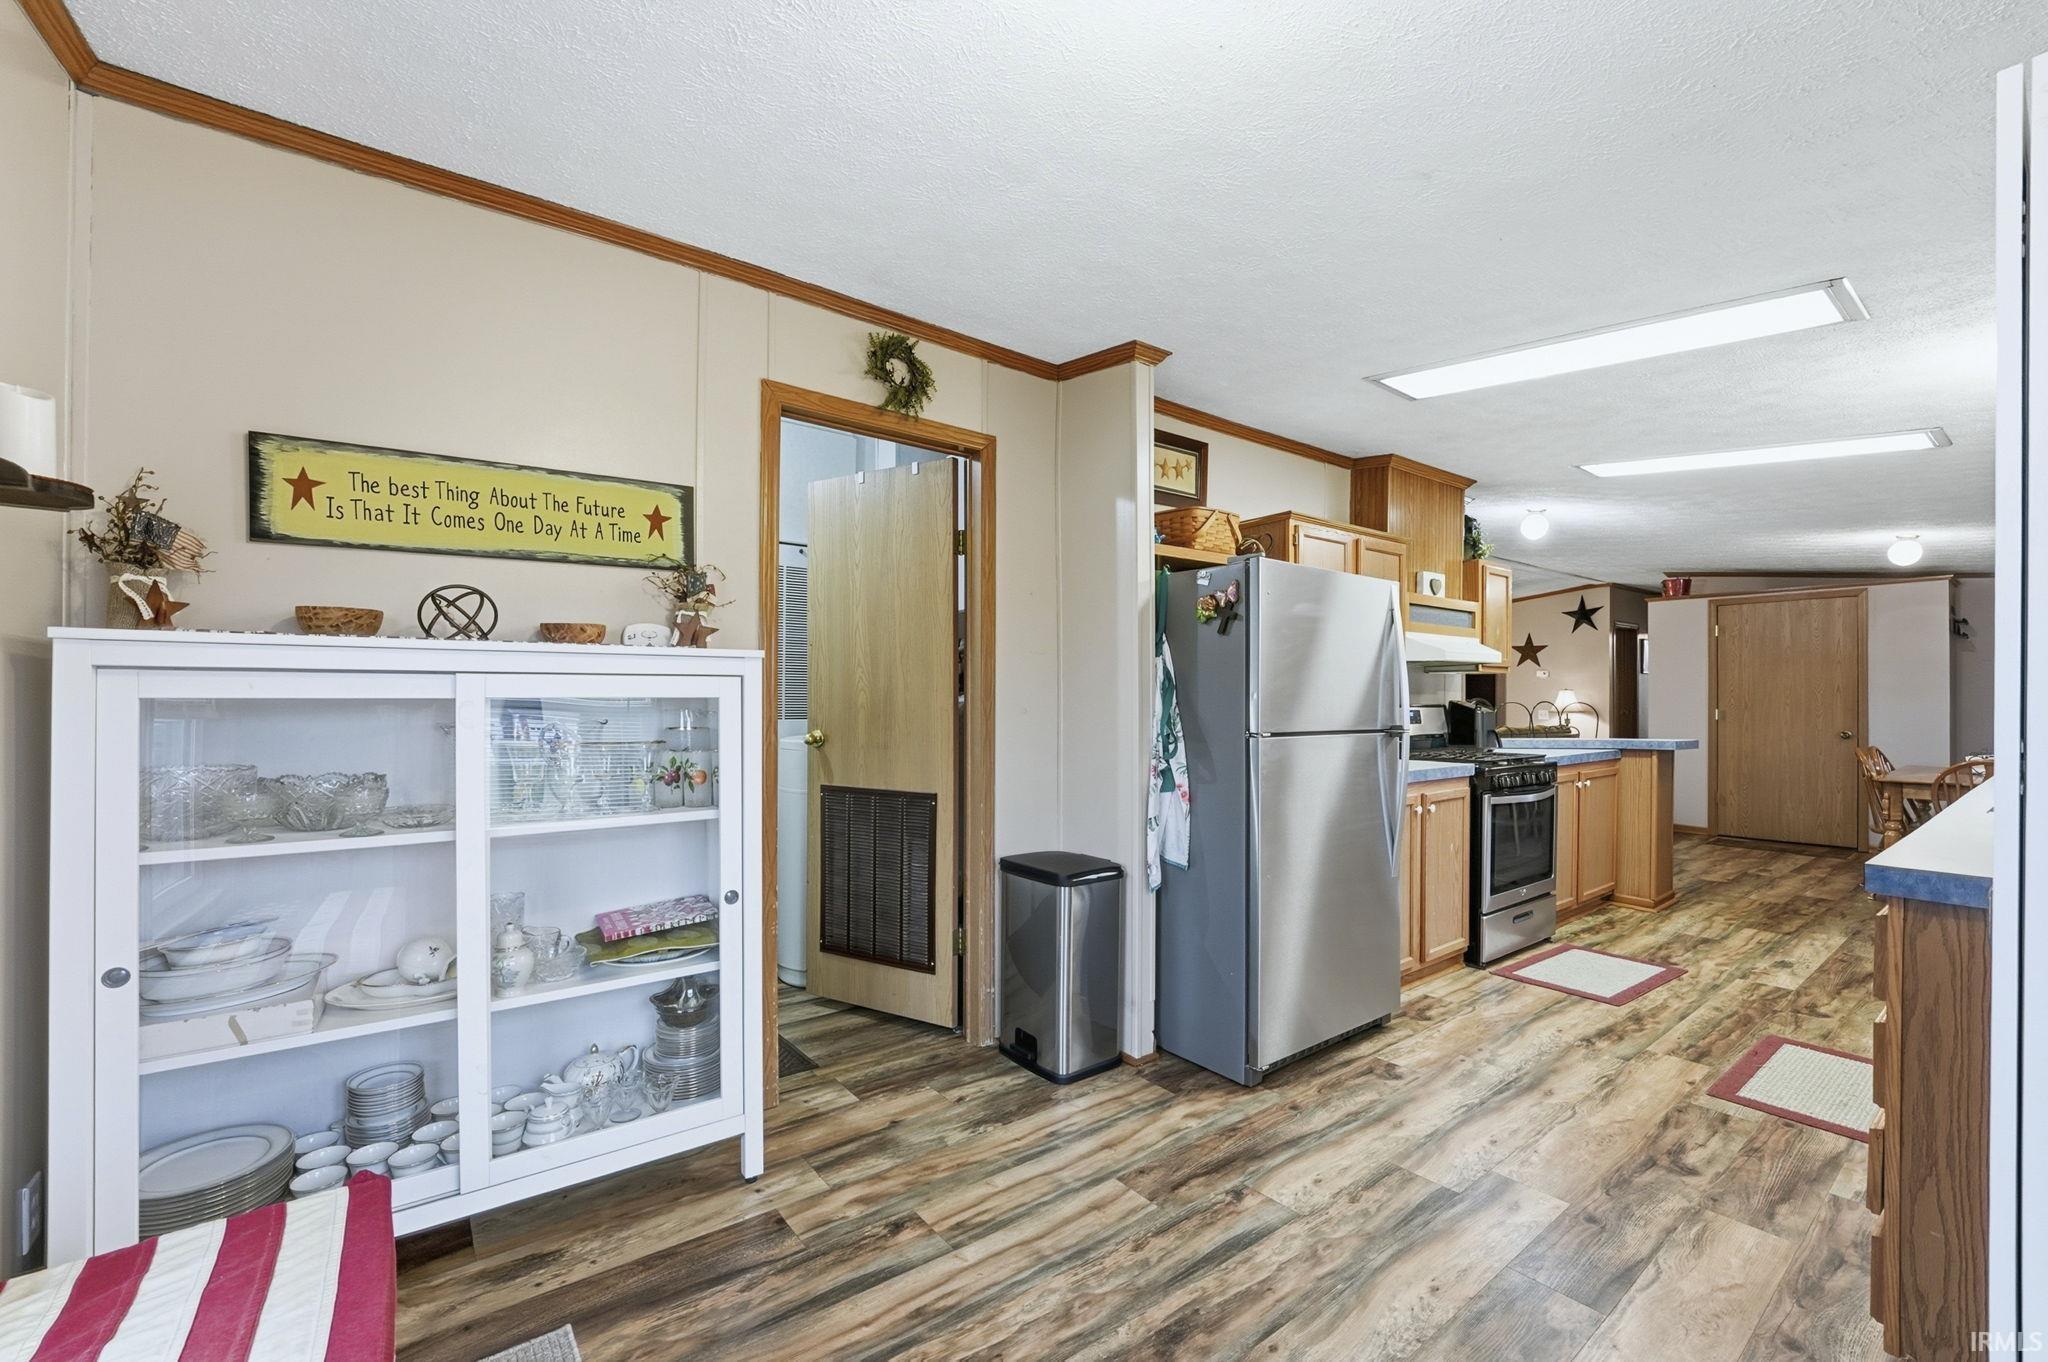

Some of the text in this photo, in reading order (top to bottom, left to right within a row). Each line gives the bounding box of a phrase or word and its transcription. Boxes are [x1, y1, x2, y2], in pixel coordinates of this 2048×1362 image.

[348, 471, 626, 519] The best Thing About The Future
[326, 496, 642, 543] Is That It Comes One Day At A Time
